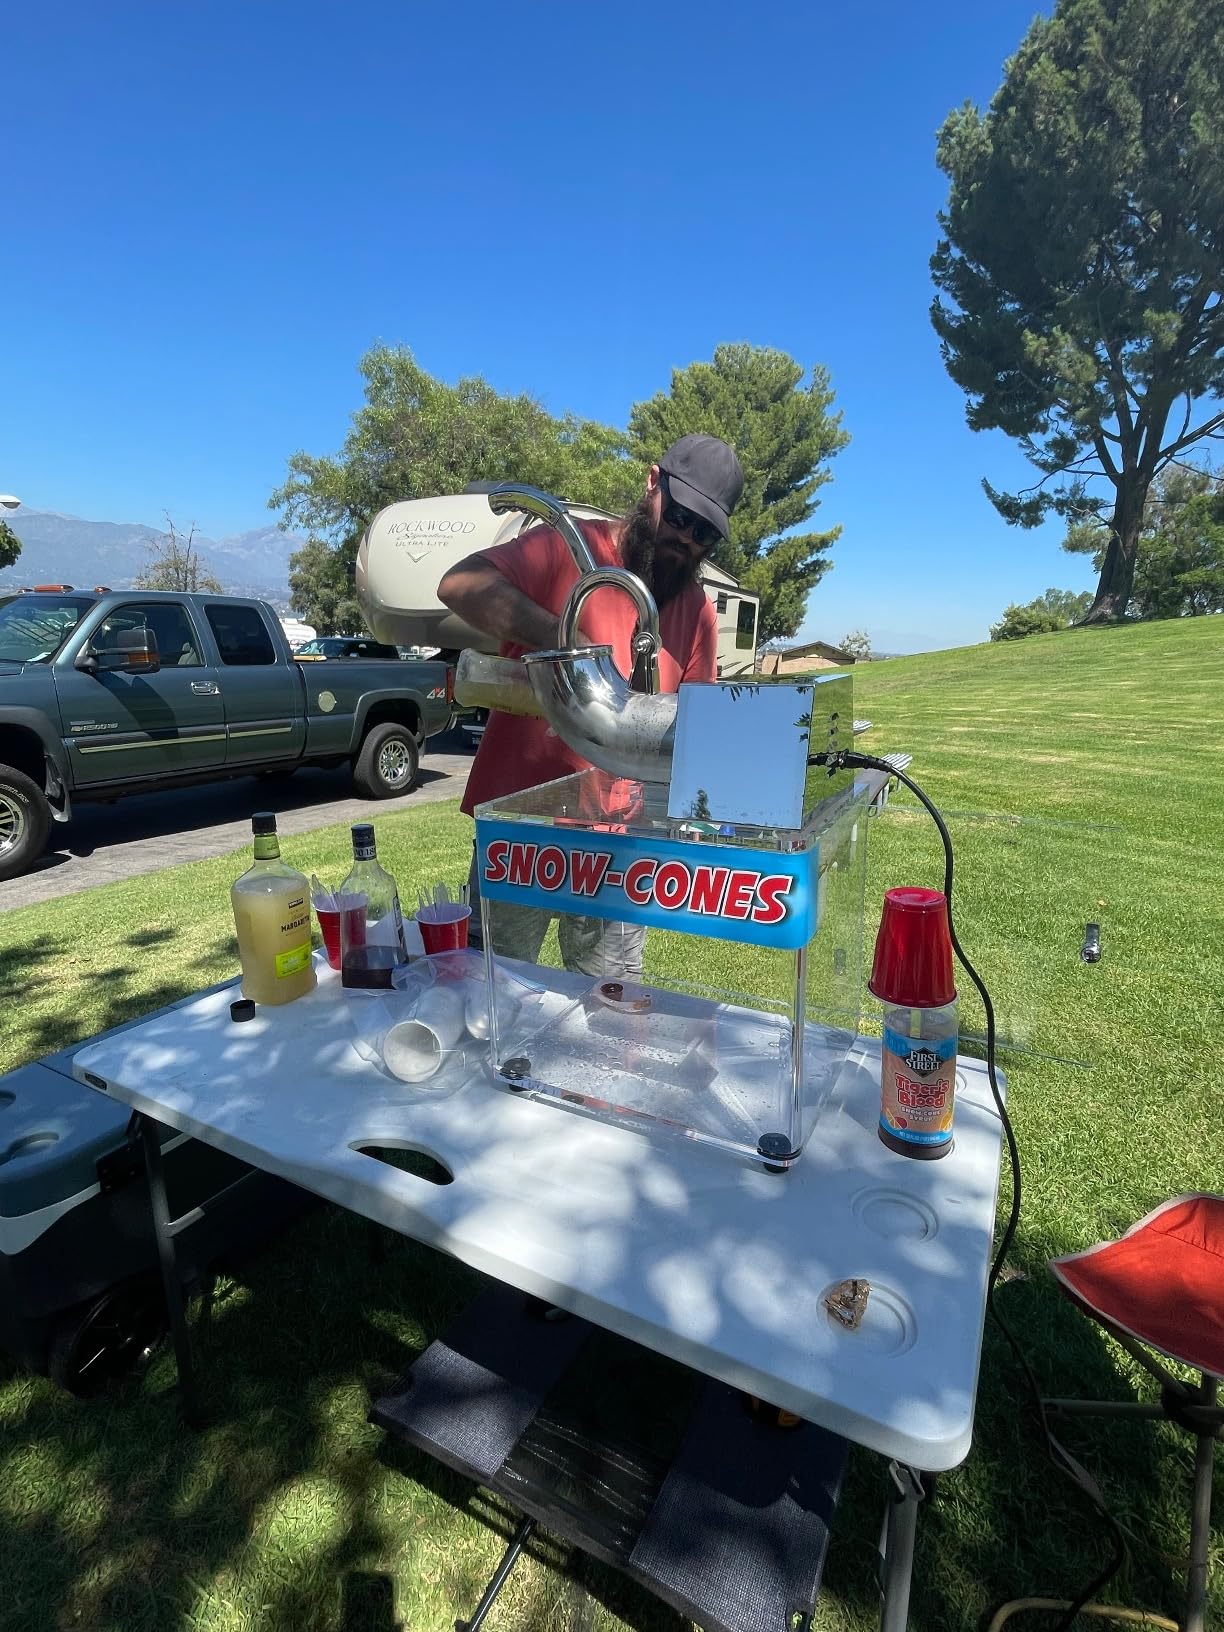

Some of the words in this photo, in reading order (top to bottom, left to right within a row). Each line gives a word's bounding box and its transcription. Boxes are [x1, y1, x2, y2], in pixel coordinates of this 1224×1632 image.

[387, 520, 476, 535] ROCKWOOD
[484, 840, 793, 925] SNOW-CONES
[910, 1050, 939, 1063] FIRST
[905, 1058, 942, 1071] STREET
[896, 1073, 949, 1095] Tiger's
[898, 1090, 945, 1107] Blood
[901, 1106, 922, 1116] SNOW
